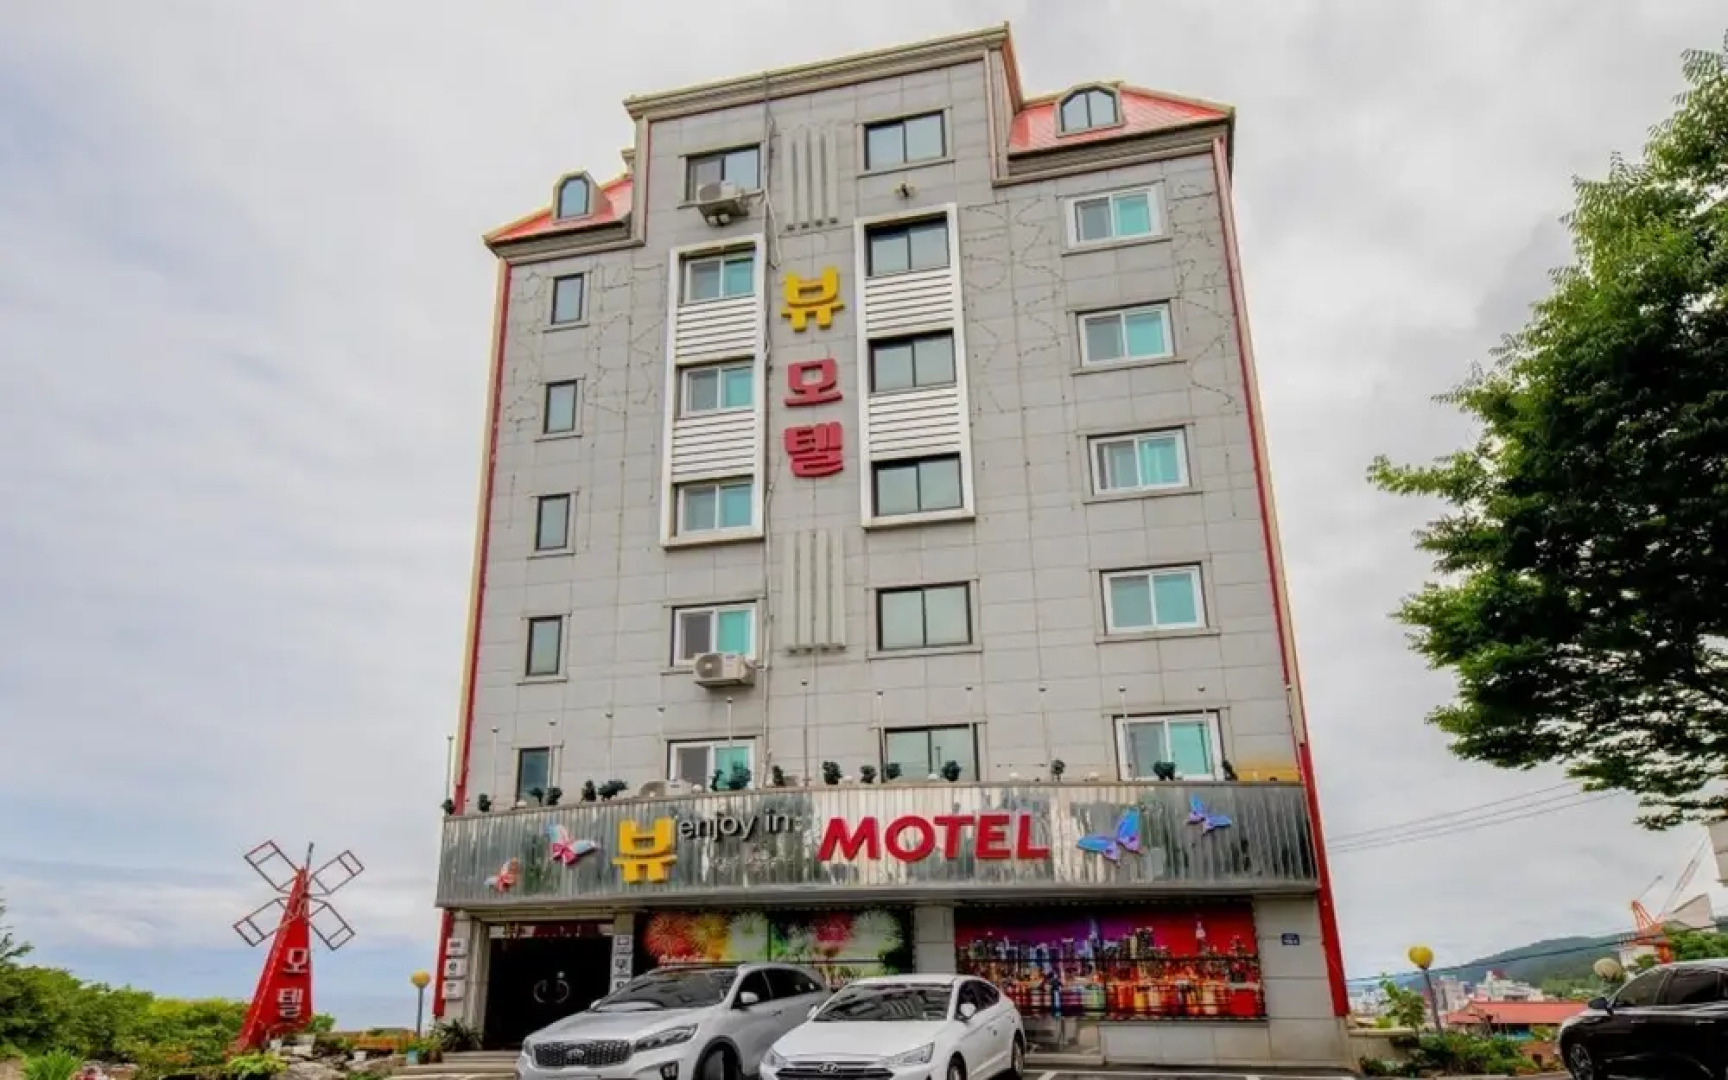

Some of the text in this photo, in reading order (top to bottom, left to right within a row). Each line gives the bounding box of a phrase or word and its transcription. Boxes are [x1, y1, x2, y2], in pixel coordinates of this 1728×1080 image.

[781, 265, 846, 478] 뷰 모텔
[612, 816, 678, 883] 뷰
[678, 812, 758, 842] enjoy
[816, 812, 1051, 864] MOTEL
[277, 947, 308, 1019] 모텔
